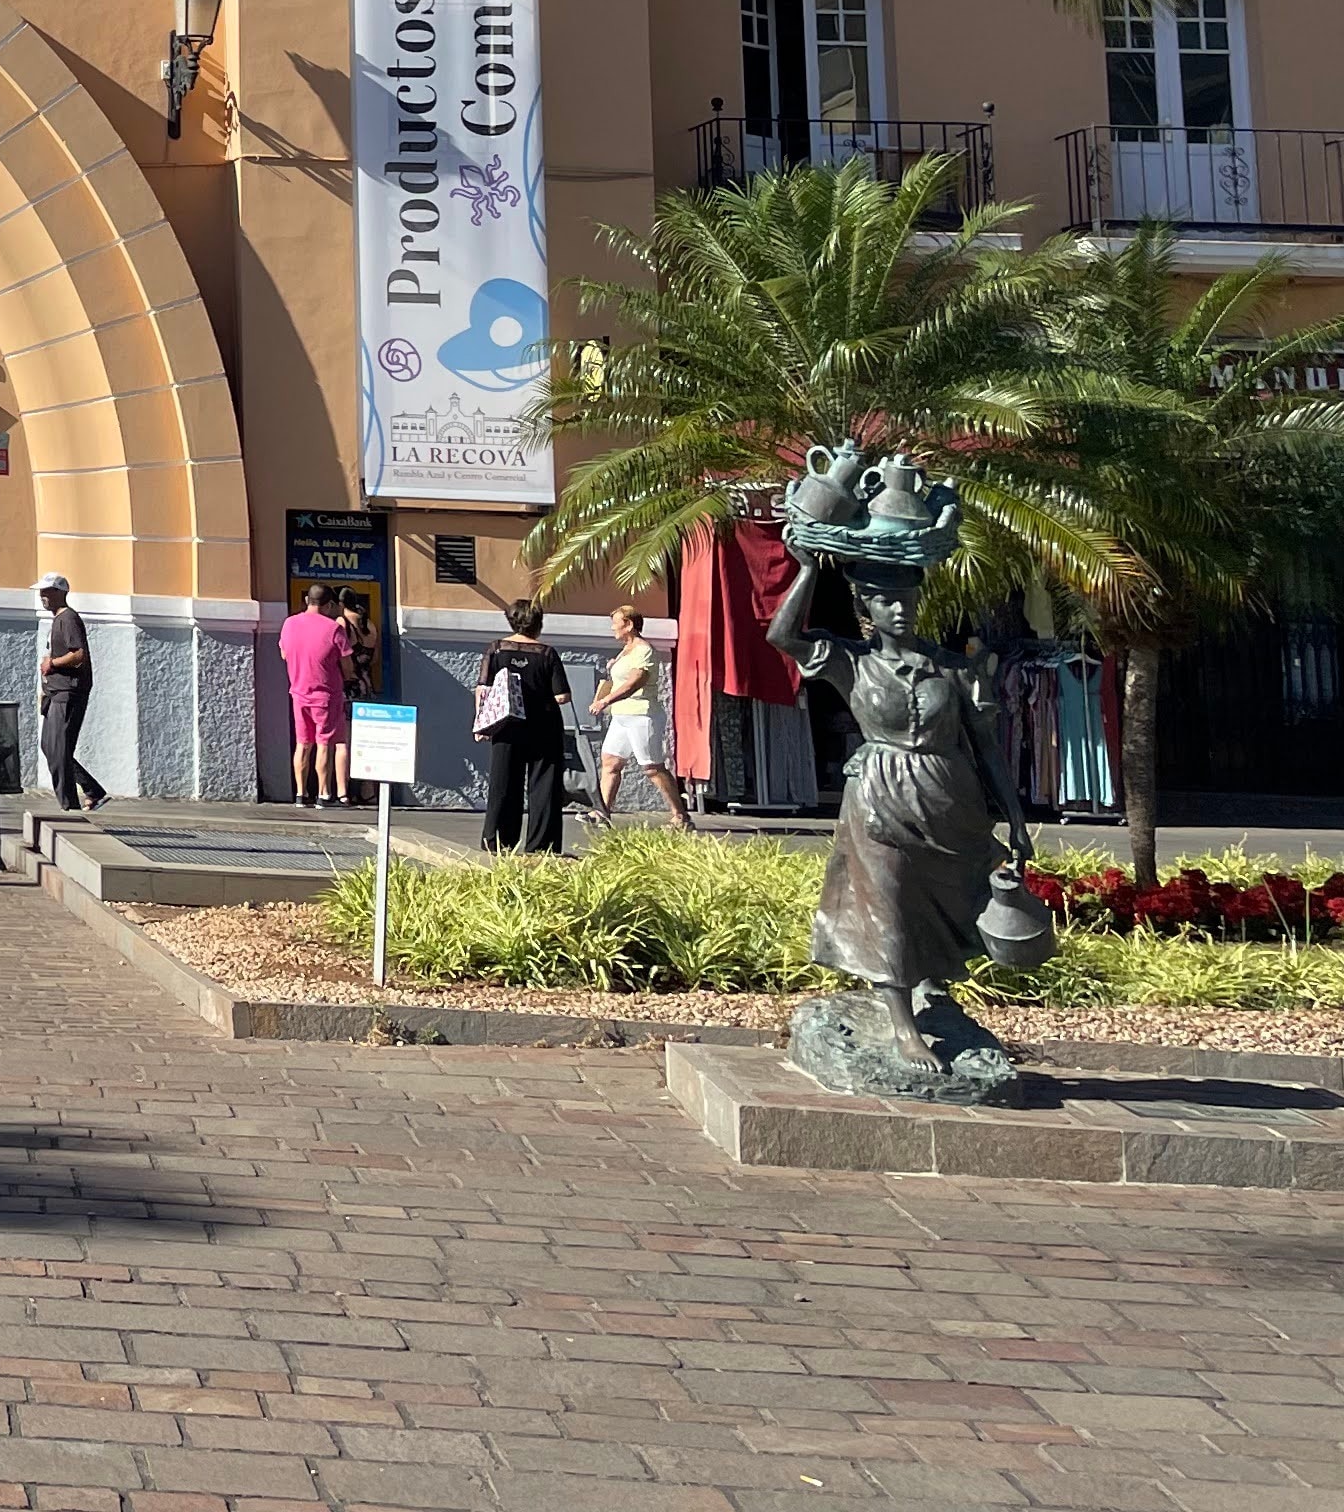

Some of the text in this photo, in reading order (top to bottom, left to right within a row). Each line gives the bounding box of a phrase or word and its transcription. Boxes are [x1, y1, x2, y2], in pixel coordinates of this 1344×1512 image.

[1209, 364, 1344, 391] MNU
[391, 446, 527, 467] LA RECOVA
[317, 514, 372, 527] CaixaBank
[309, 551, 359, 570] ATM
